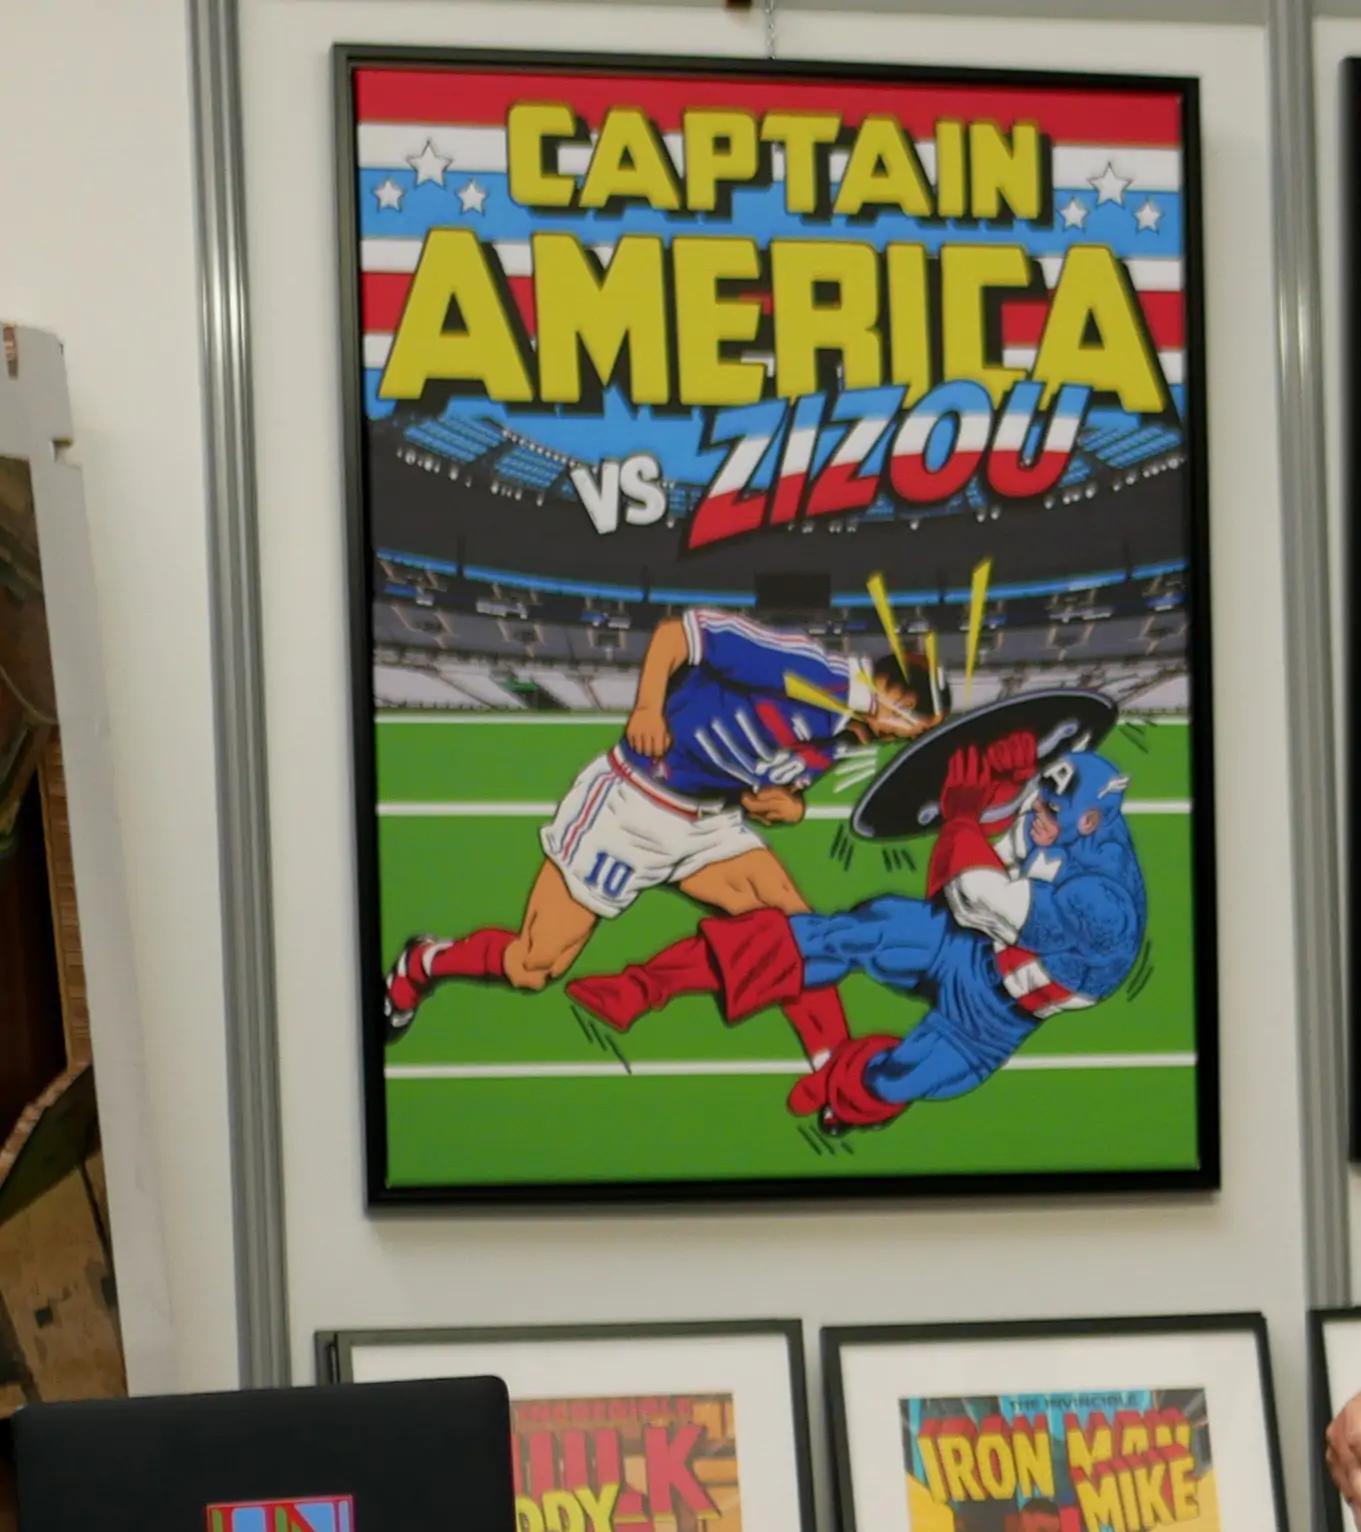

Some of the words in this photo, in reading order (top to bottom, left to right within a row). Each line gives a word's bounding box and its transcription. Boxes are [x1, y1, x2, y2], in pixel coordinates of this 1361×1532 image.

[508, 100, 1048, 222] CAPTAIN
[377, 227, 1168, 415] AMERICA
[569, 453, 670, 535] VS
[682, 378, 1094, 552] ZIZOU
[584, 851, 636, 898] 10
[917, 1414, 1055, 1503] IRON
